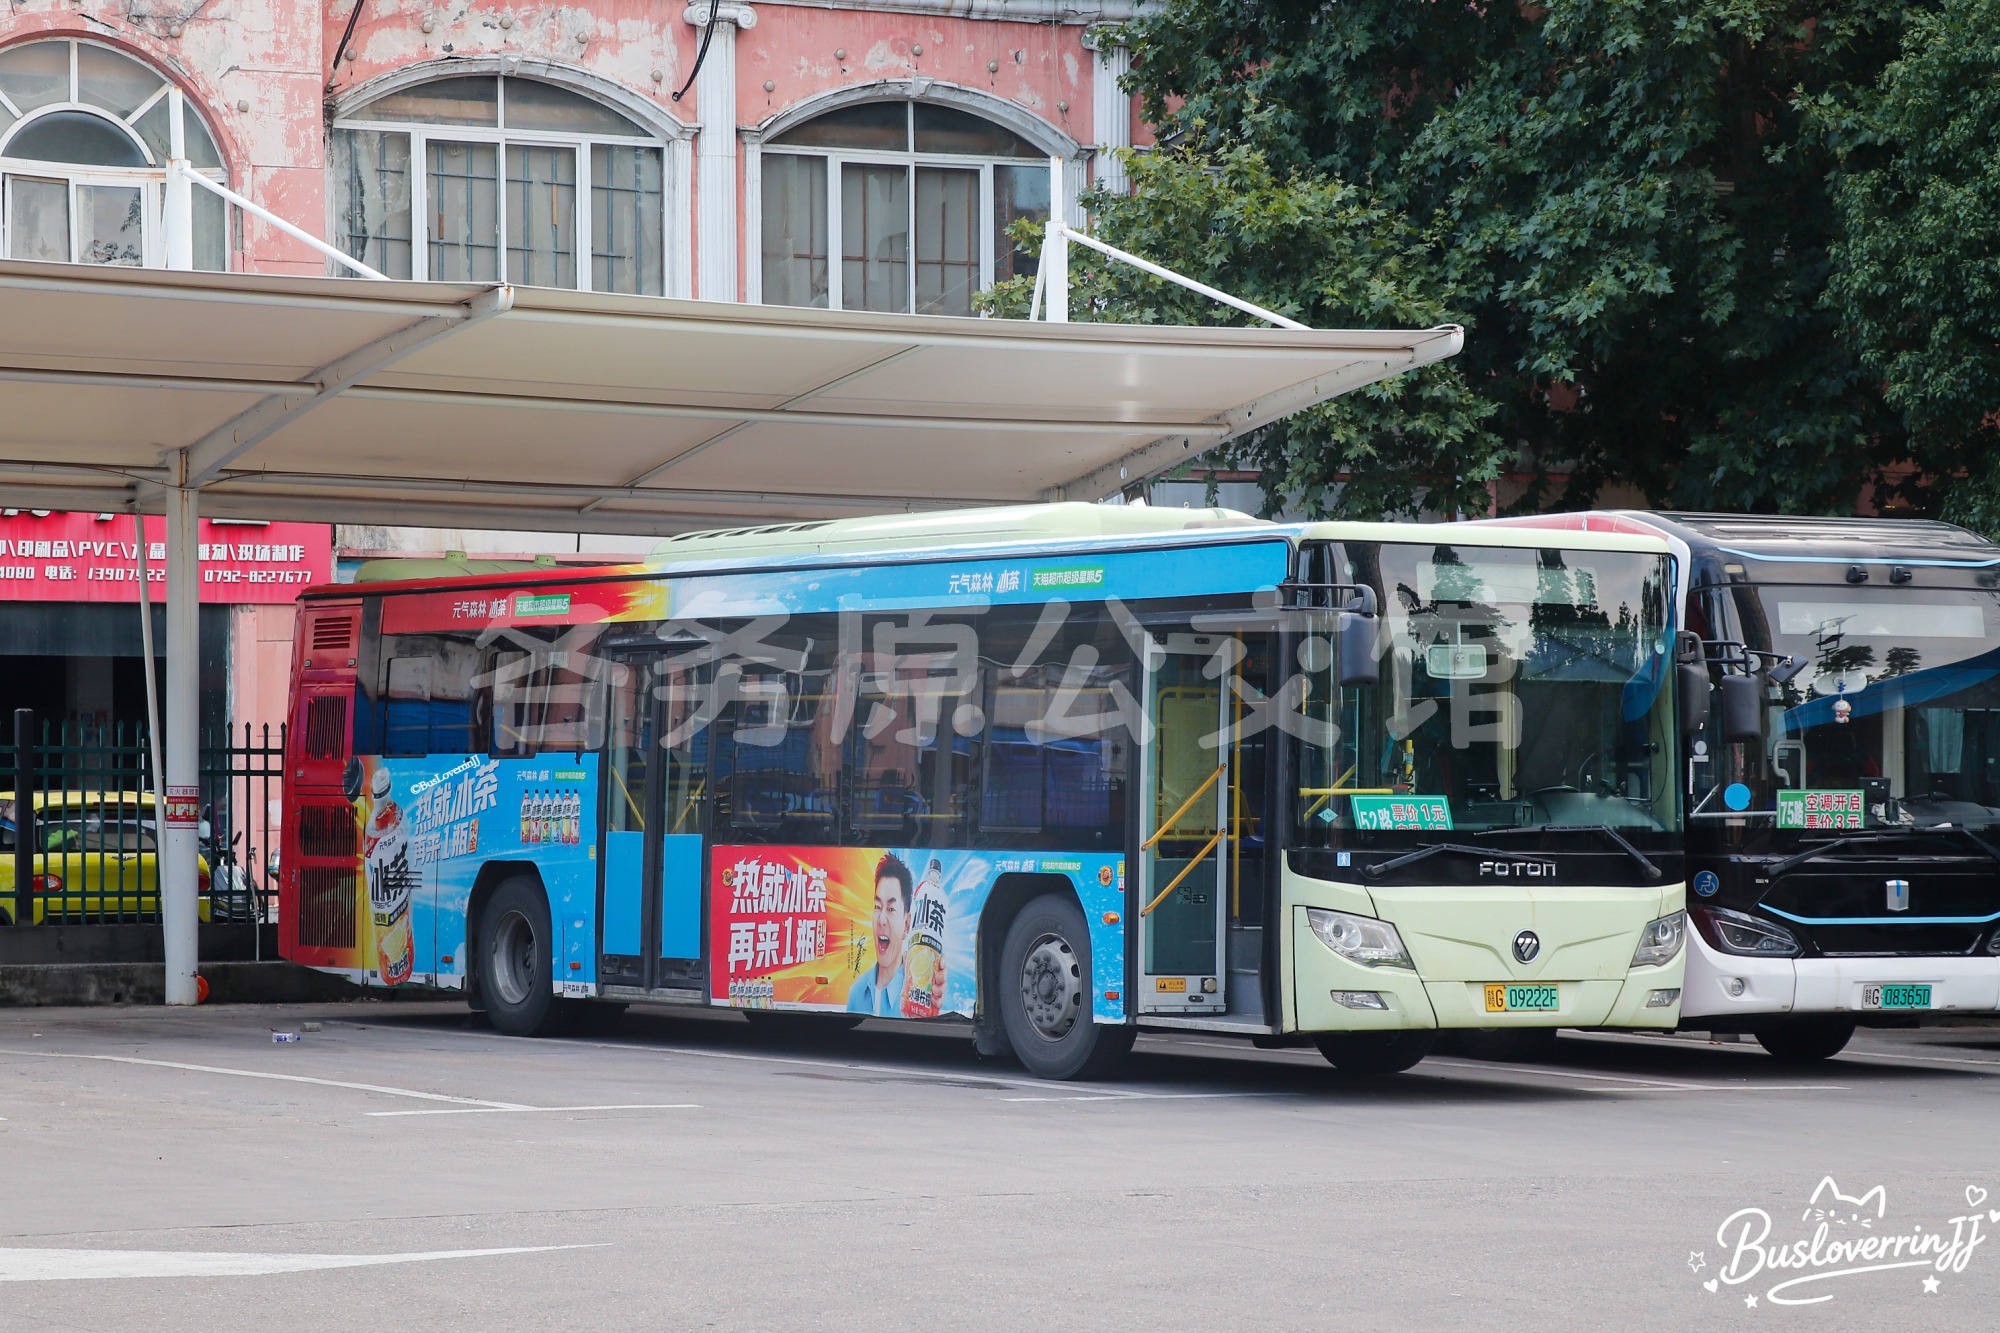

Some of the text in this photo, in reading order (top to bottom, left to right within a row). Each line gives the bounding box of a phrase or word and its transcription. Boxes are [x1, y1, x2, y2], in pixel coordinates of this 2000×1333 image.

[204, 569, 312, 583] 0792-8227677
[949, 569, 1104, 594] 元气森林 冰茶 天猫超市超级星期5
[452, 600, 487, 619] 元气森林
[1805, 793, 1860, 812] 空调开启
[1391, 803, 1446, 822] 票价1元
[1780, 799, 1804, 826] 75路
[1805, 813, 1861, 829] 票价3元
[1479, 861, 1557, 877] FOTON
[729, 854, 828, 914] 热就冰茶
[912, 893, 947, 938] 冰茶
[728, 916, 817, 973] 再来1瓶
